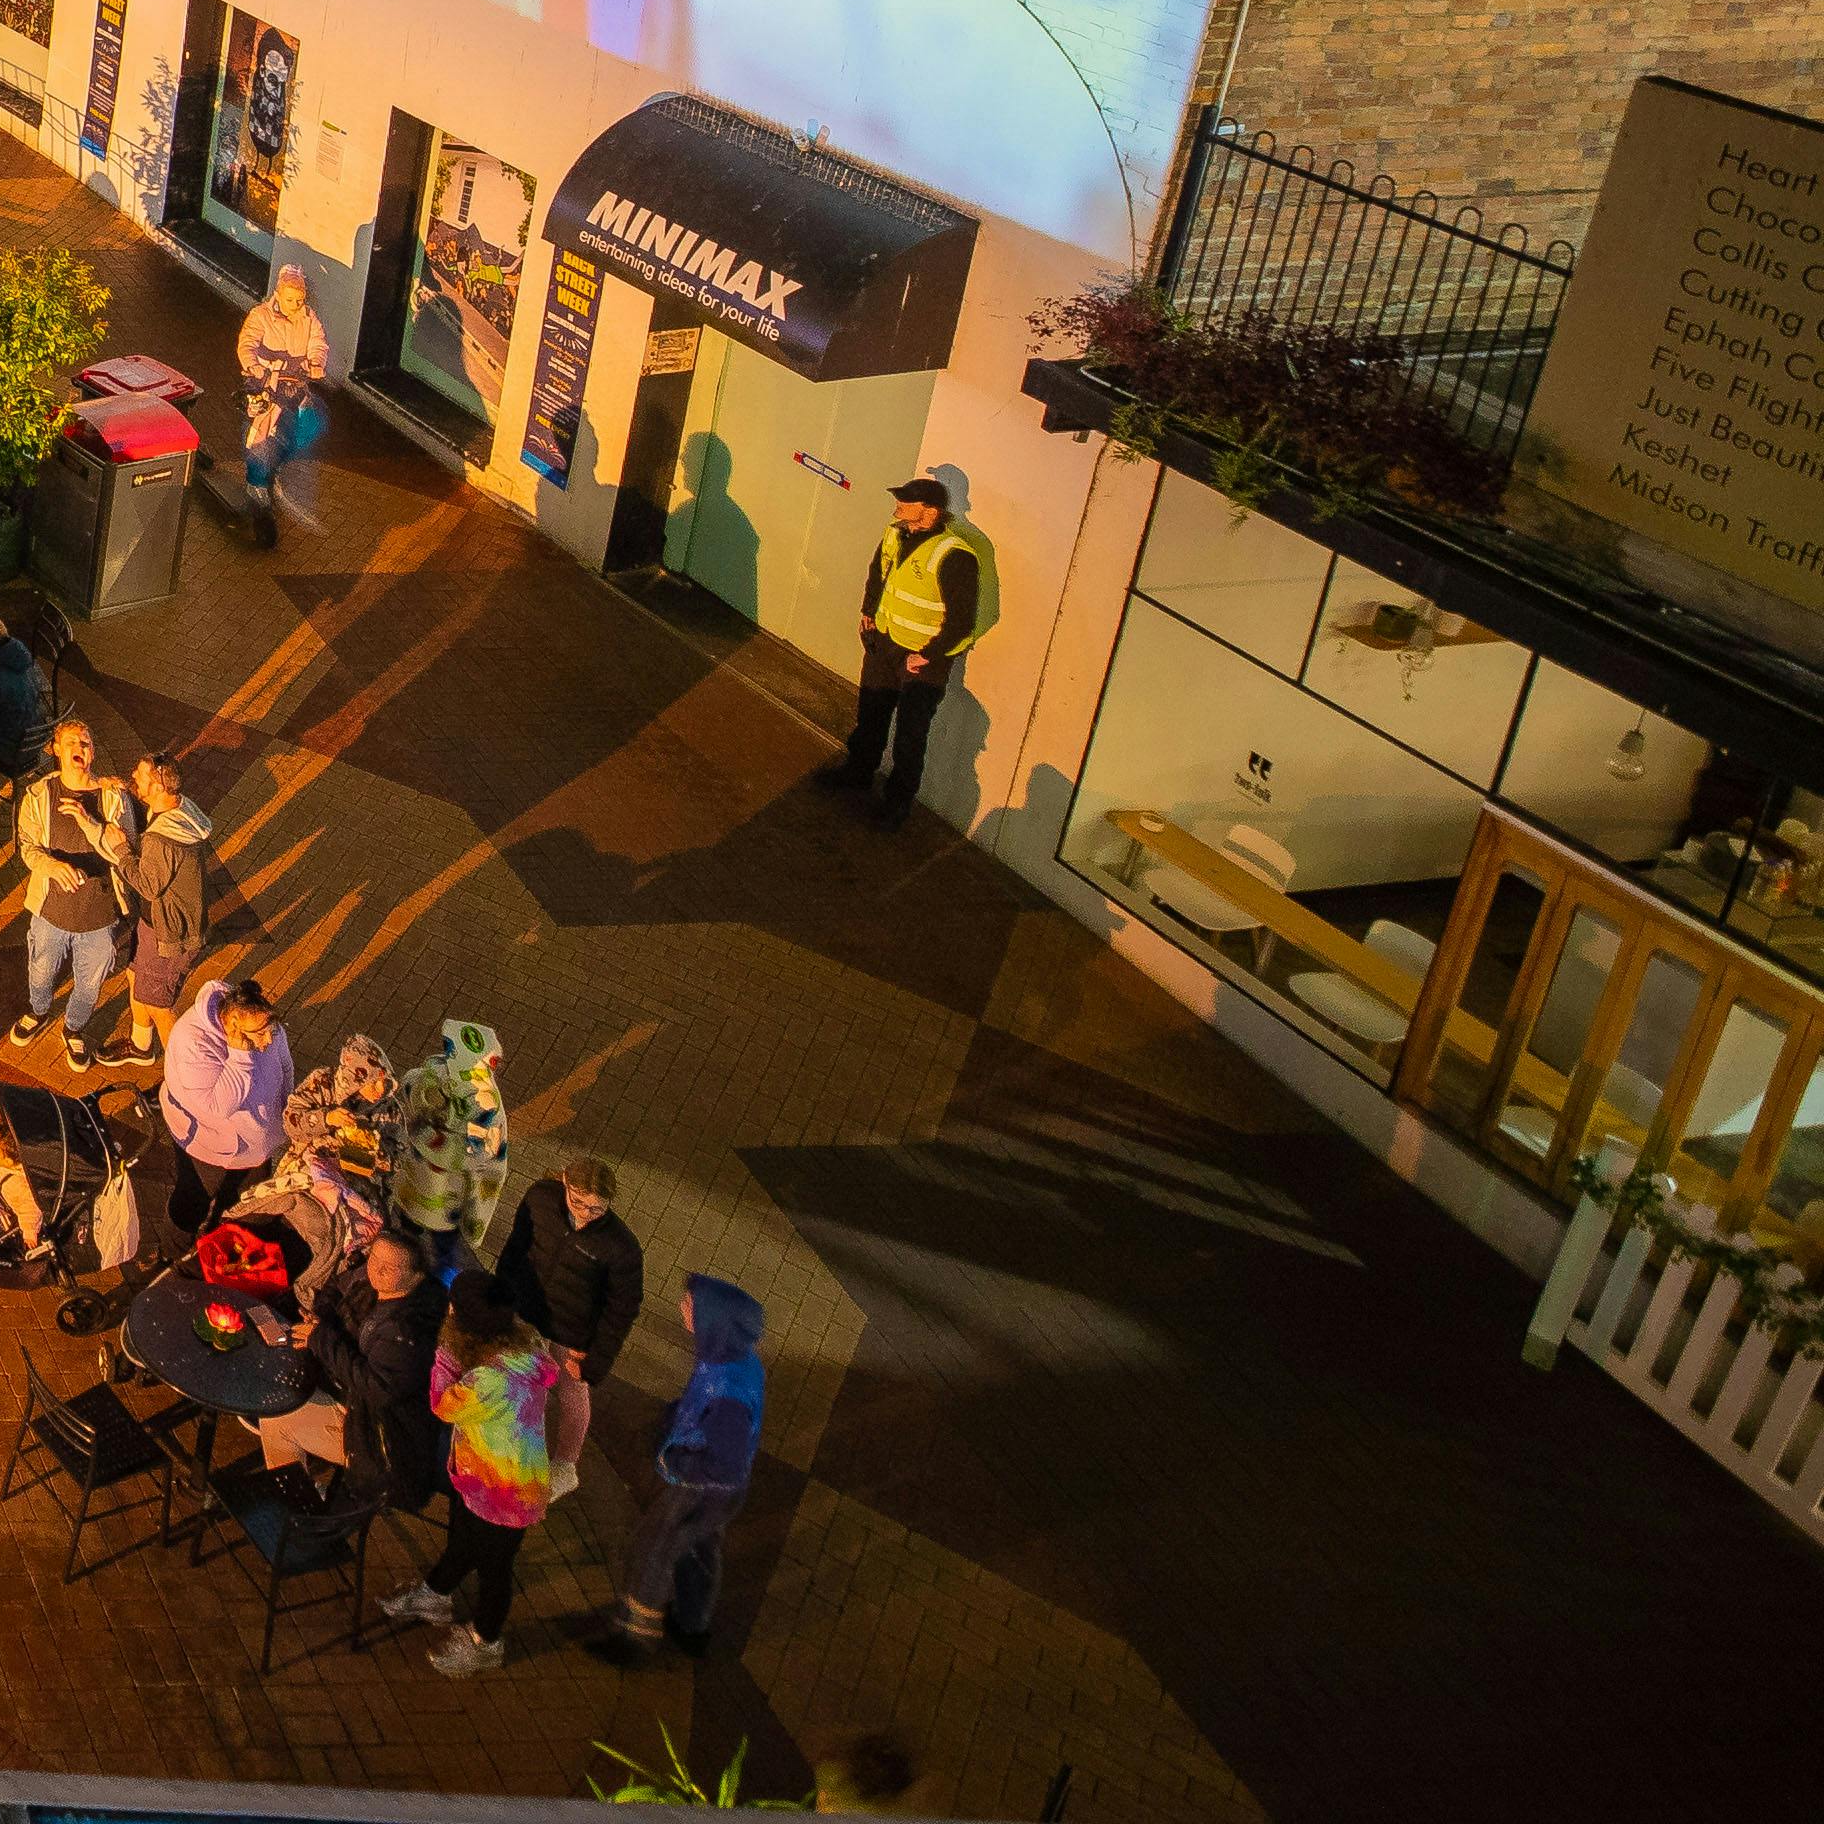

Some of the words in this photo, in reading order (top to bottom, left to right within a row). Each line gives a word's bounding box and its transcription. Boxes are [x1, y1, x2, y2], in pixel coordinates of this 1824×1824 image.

[1706, 185, 1823, 244] Choco
[555, 264, 598, 300] STREET
[579, 230, 656, 281] entertaining
[658, 264, 695, 299] ideas
[698, 285, 720, 310] for
[722, 299, 756, 326] your
[757, 316, 781, 342] life
[586, 190, 803, 322] MINIMAX
[1693, 227, 1790, 281] Collis
[557, 285, 591, 318] WEEK
[1680, 268, 1804, 338] Cutting
[1652, 344, 1715, 391] Five
[1663, 305, 1772, 368] Ephah
[1621, 422, 1733, 488] Keshet
[1638, 387, 1701, 426] Just
[1710, 413, 1824, 484] Beauti
[1607, 463, 1730, 533] Midson
[1747, 517, 1824, 576] Traff
